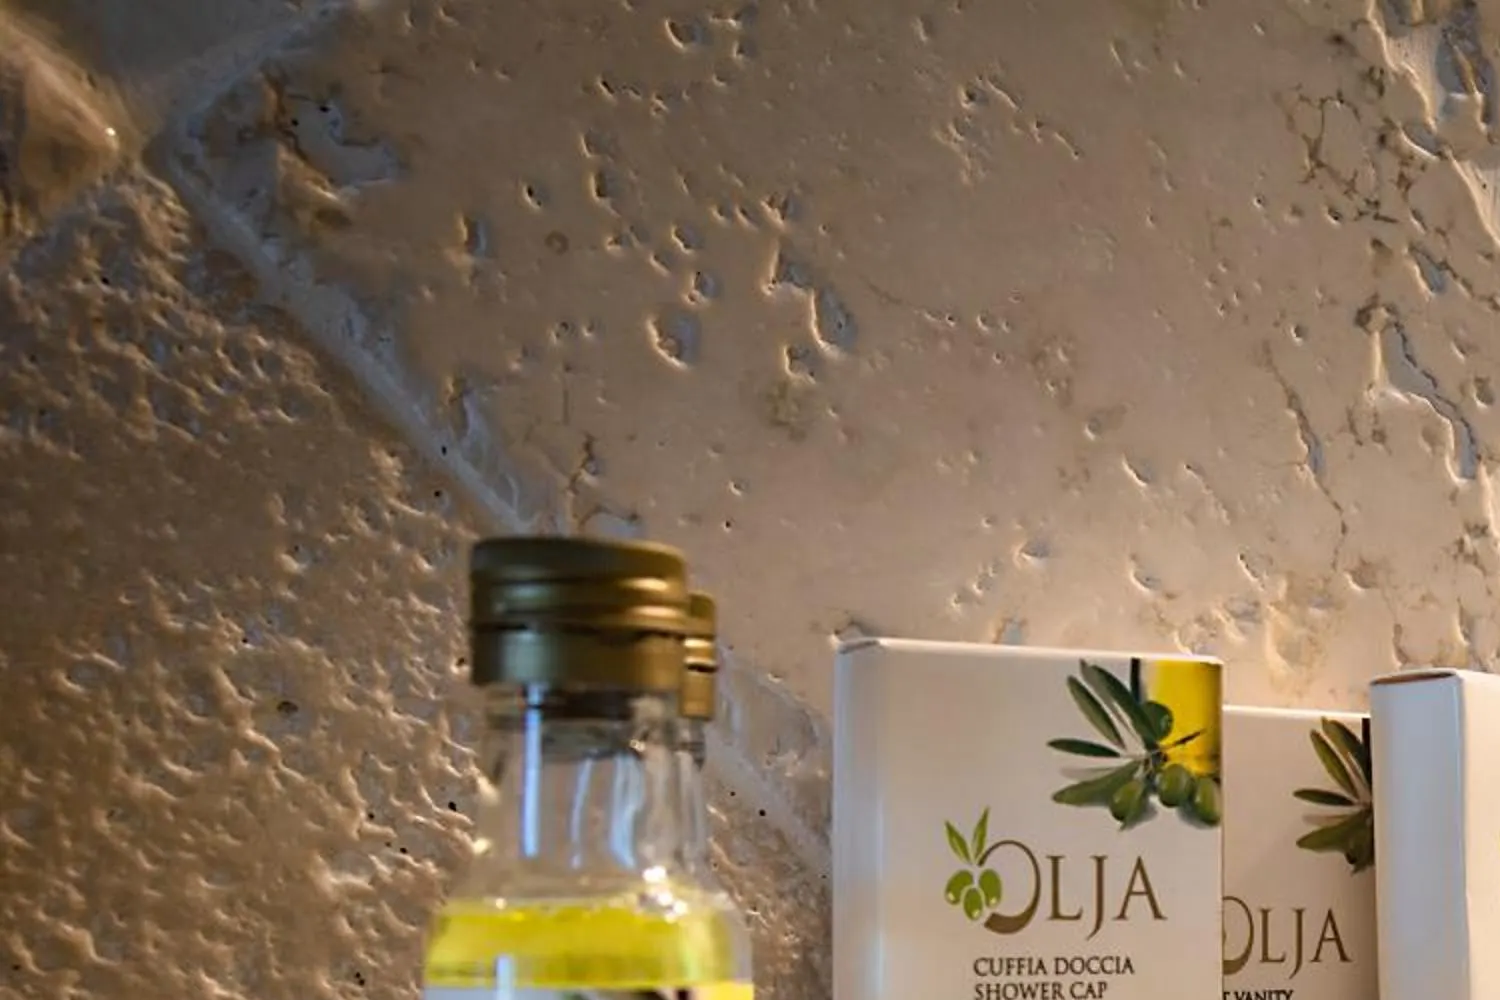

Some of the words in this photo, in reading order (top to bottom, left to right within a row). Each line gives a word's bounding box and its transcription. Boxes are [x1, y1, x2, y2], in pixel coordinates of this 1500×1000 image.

[979, 839, 1168, 941] OLJA
[973, 956, 1048, 976] CUFFIA
[1054, 955, 1135, 975] DOCCIA
[1069, 980, 1108, 1000] CAP
